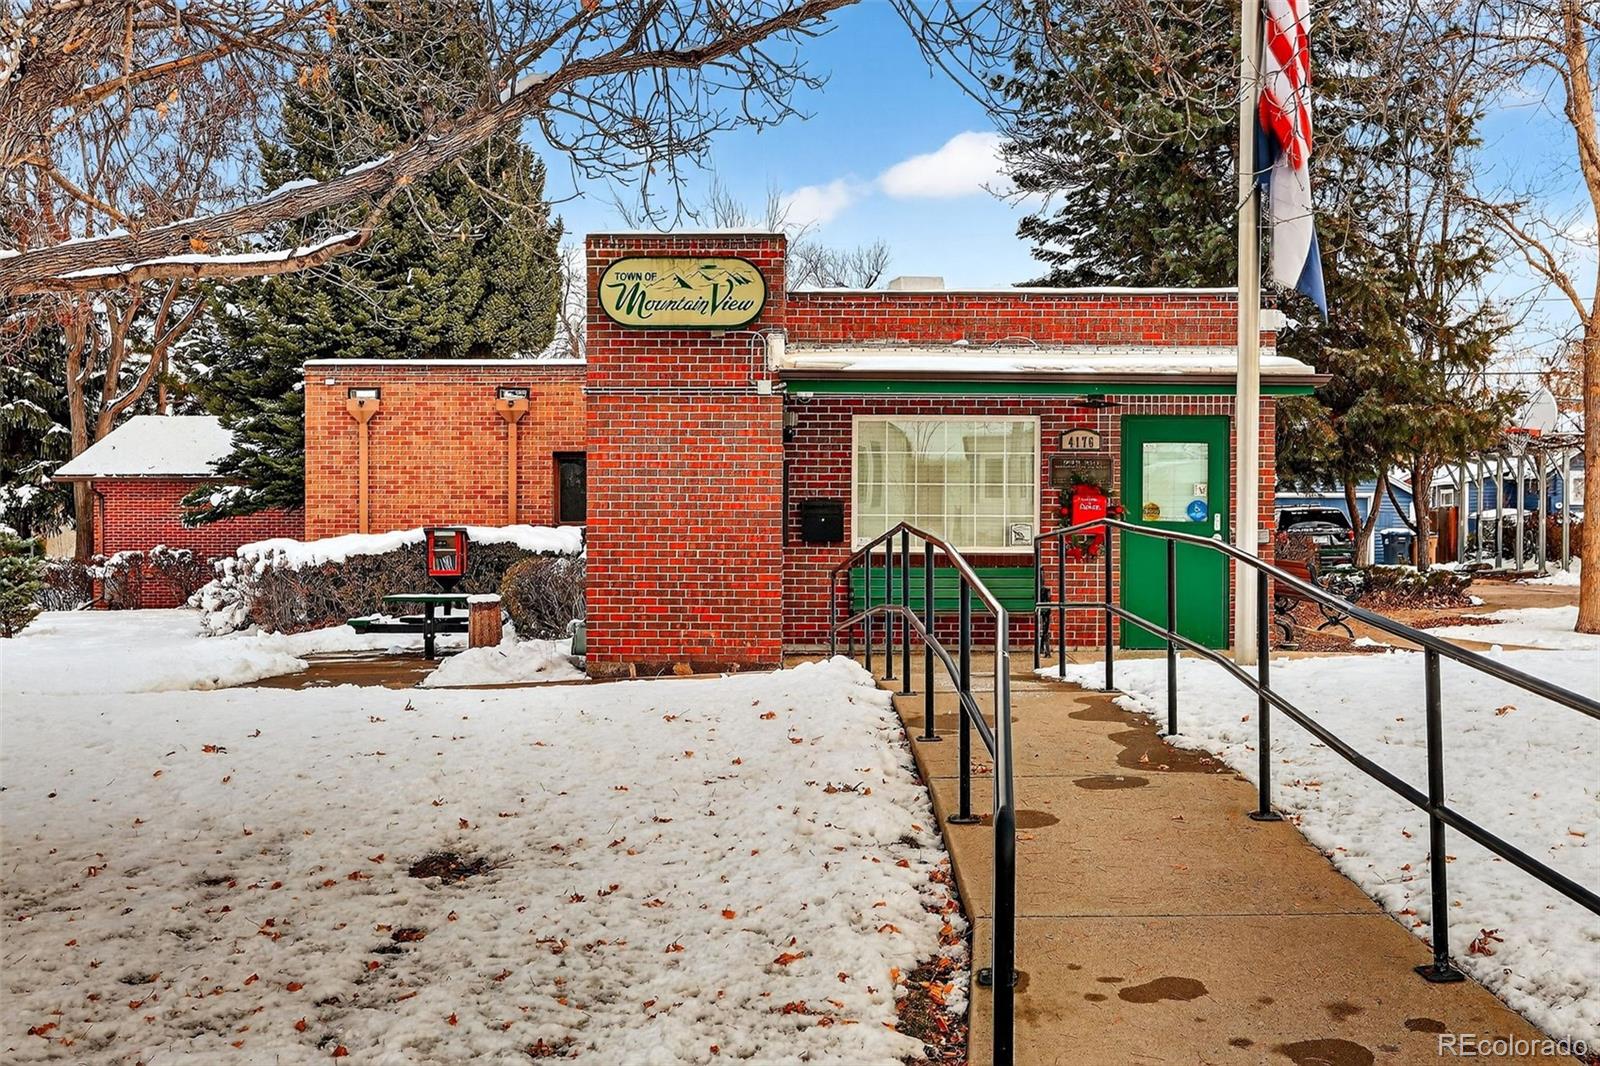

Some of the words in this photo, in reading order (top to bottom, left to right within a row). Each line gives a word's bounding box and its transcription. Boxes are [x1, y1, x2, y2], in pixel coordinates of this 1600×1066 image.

[615, 272, 642, 281] TOWN
[645, 272, 657, 281] OF
[606, 282, 710, 319] Mountain
[710, 279, 754, 317] View
[1068, 436, 1094, 448] 4176
